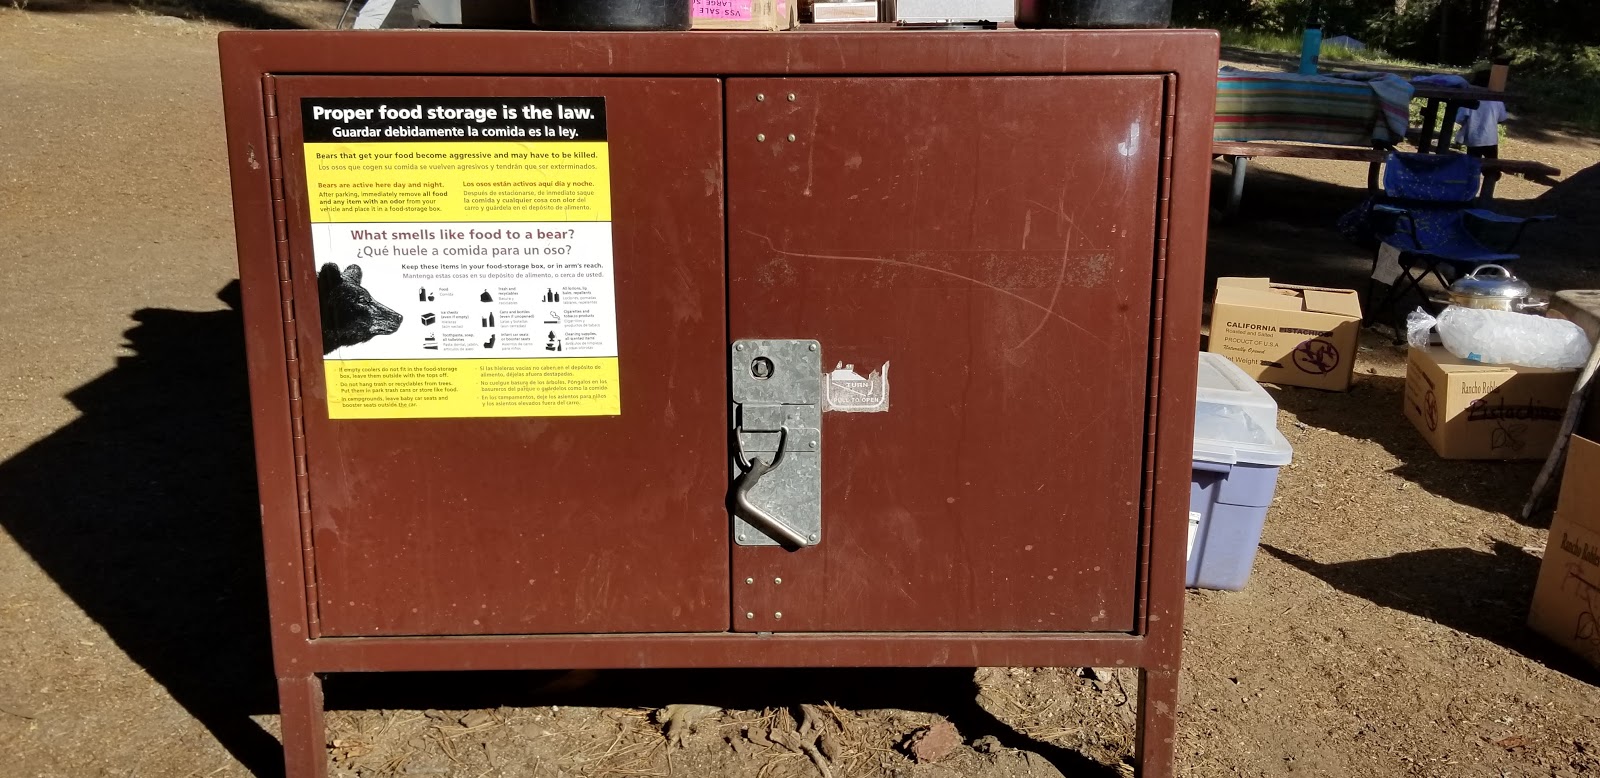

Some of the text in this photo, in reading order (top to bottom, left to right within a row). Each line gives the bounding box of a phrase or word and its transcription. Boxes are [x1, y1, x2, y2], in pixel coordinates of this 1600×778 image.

[699, 7, 720, 15] SALE
[313, 104, 594, 123] Proper food storage is the law.
[332, 125, 579, 139] Guardar debidamente la comida es la ley.
[358, 153, 372, 161] get
[449, 152, 492, 160] aggressive
[351, 229, 574, 240] What smells like food to a bear?
[357, 244, 572, 259] ¿Qué huele a comida para un oso?
[1226, 321, 1277, 332] CALIFORNIA
[1224, 337, 1253, 345] PRODUCT
[1223, 344, 1246, 353] Naturally
[1235, 356, 1258, 365] Weight
[1461, 381, 1482, 394] Rancho
[1560, 532, 1582, 558] Rancho
